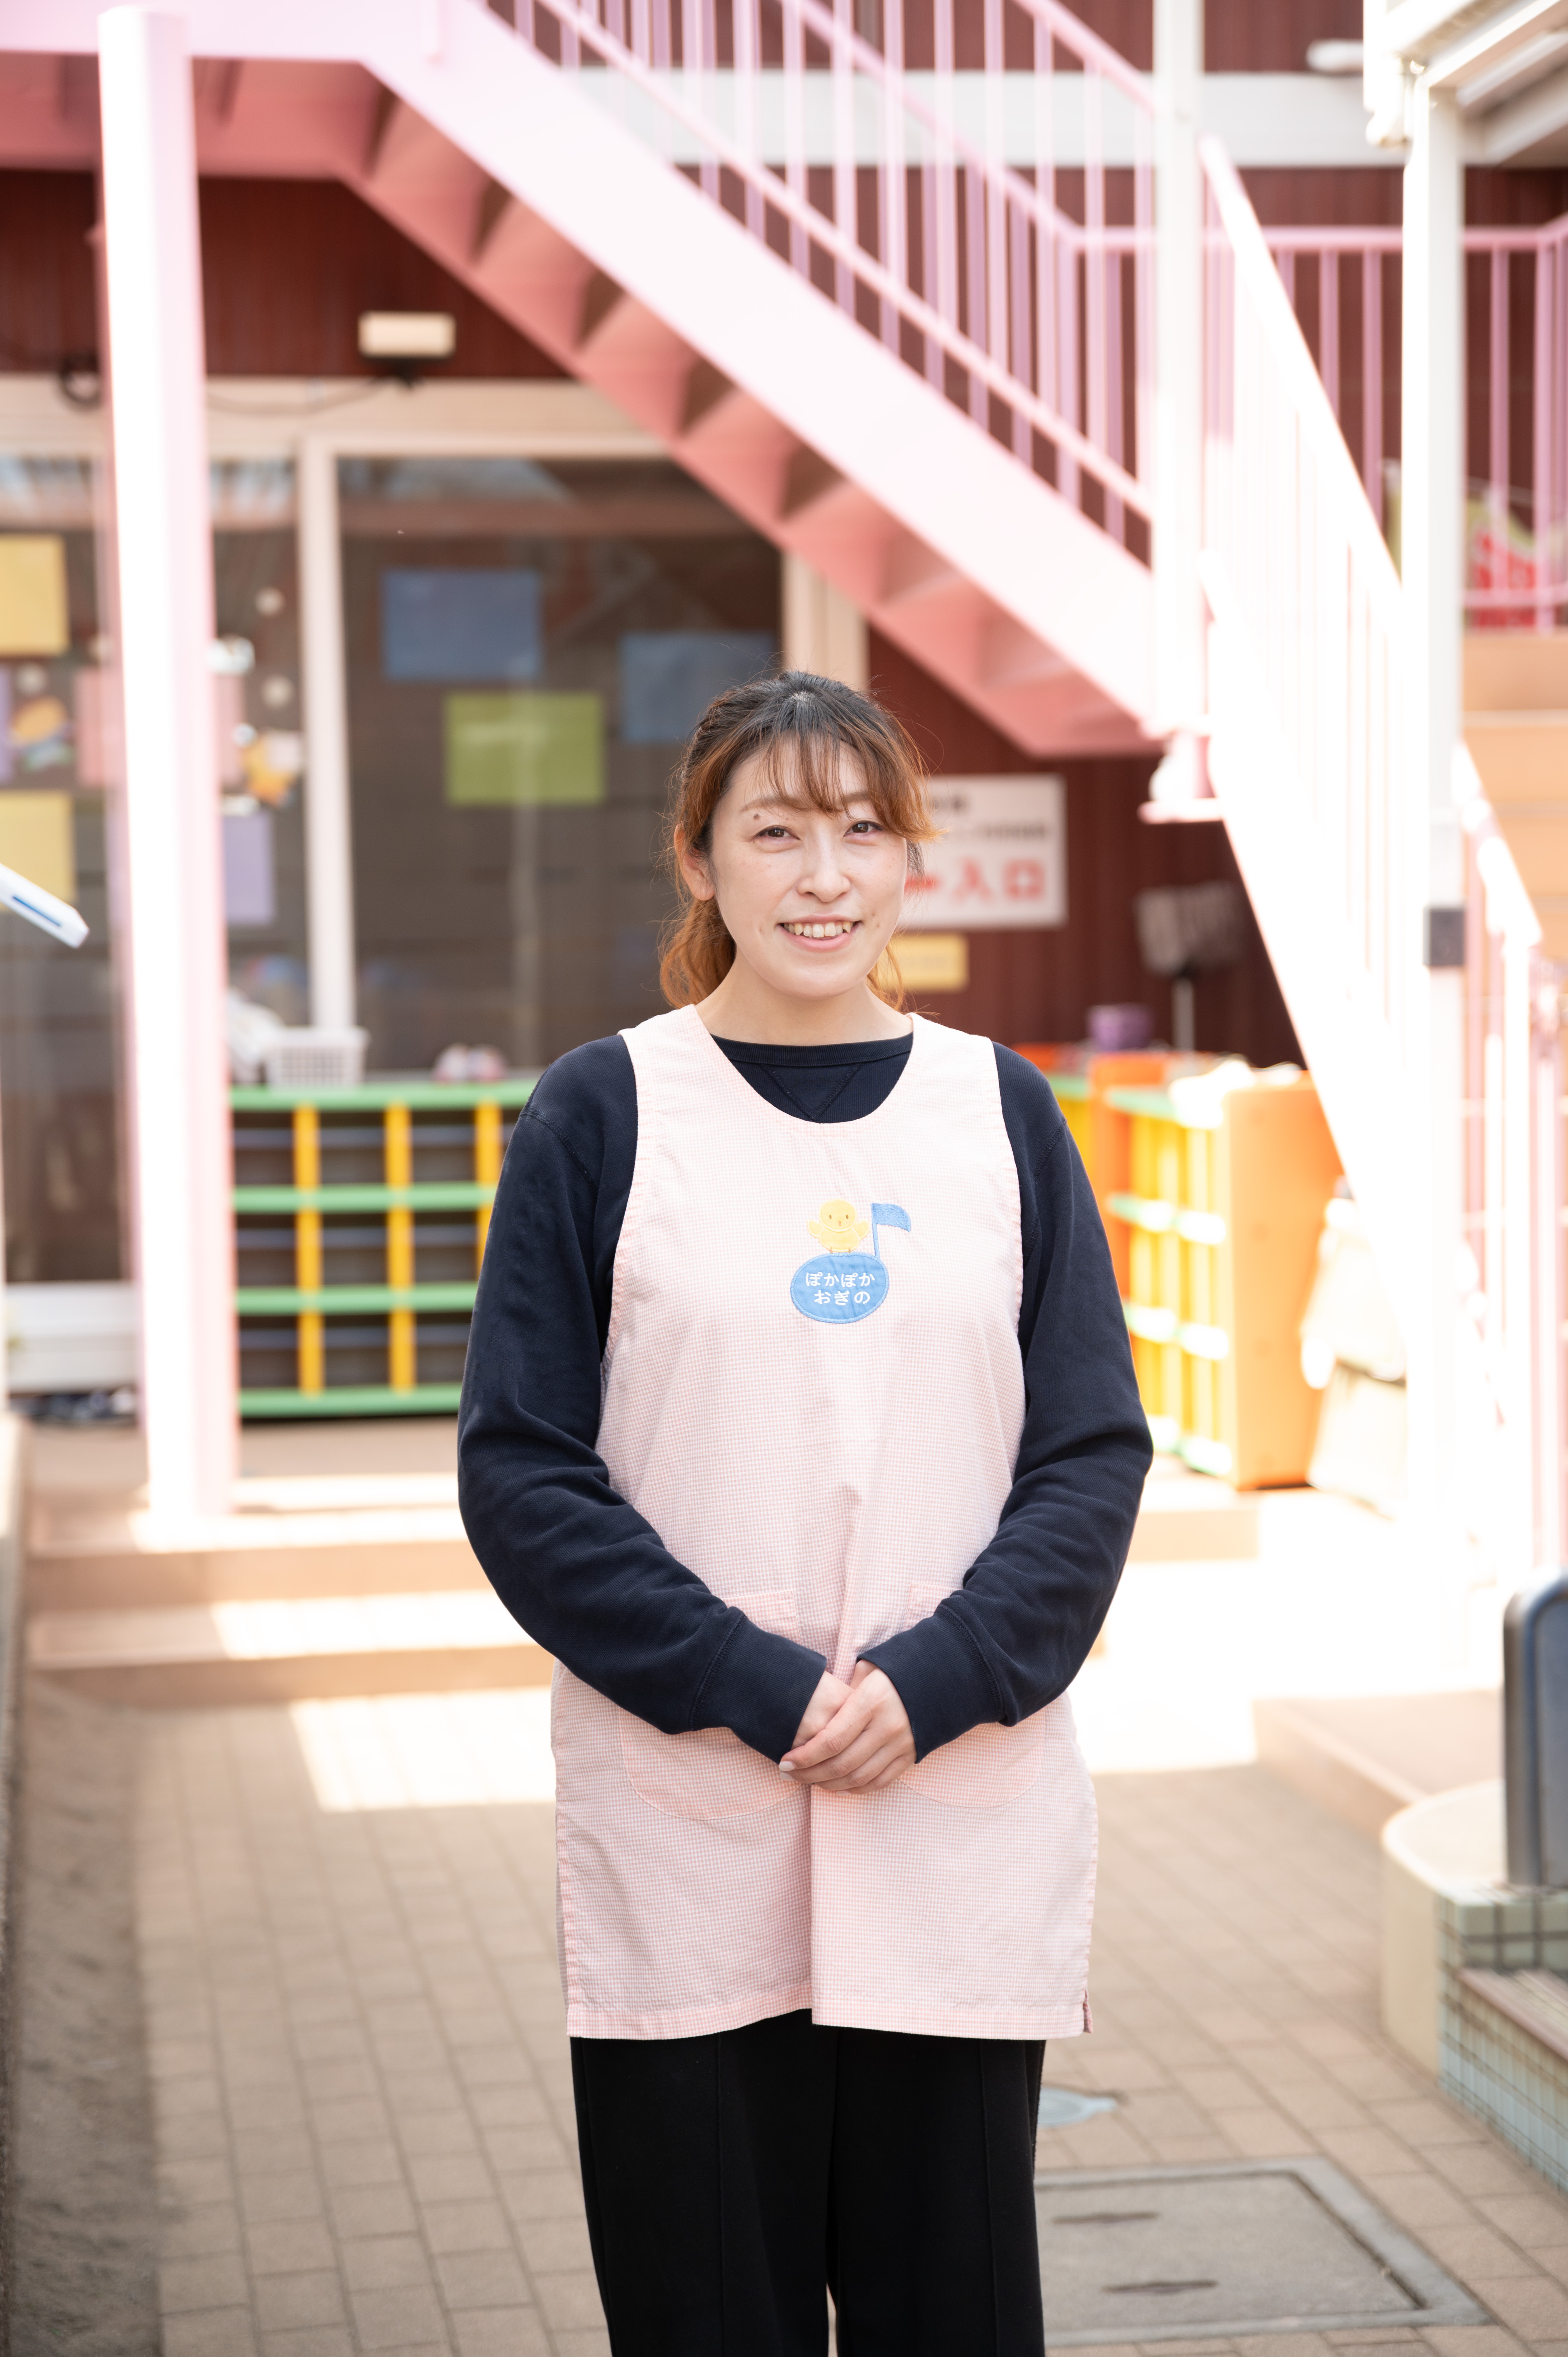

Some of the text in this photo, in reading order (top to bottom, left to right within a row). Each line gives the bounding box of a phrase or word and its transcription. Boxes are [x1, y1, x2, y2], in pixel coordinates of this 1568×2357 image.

[950, 858, 1047, 903] 入口
[805, 1272, 875, 1287] ぽかぽか
[814, 1290, 871, 1305] おぎの
